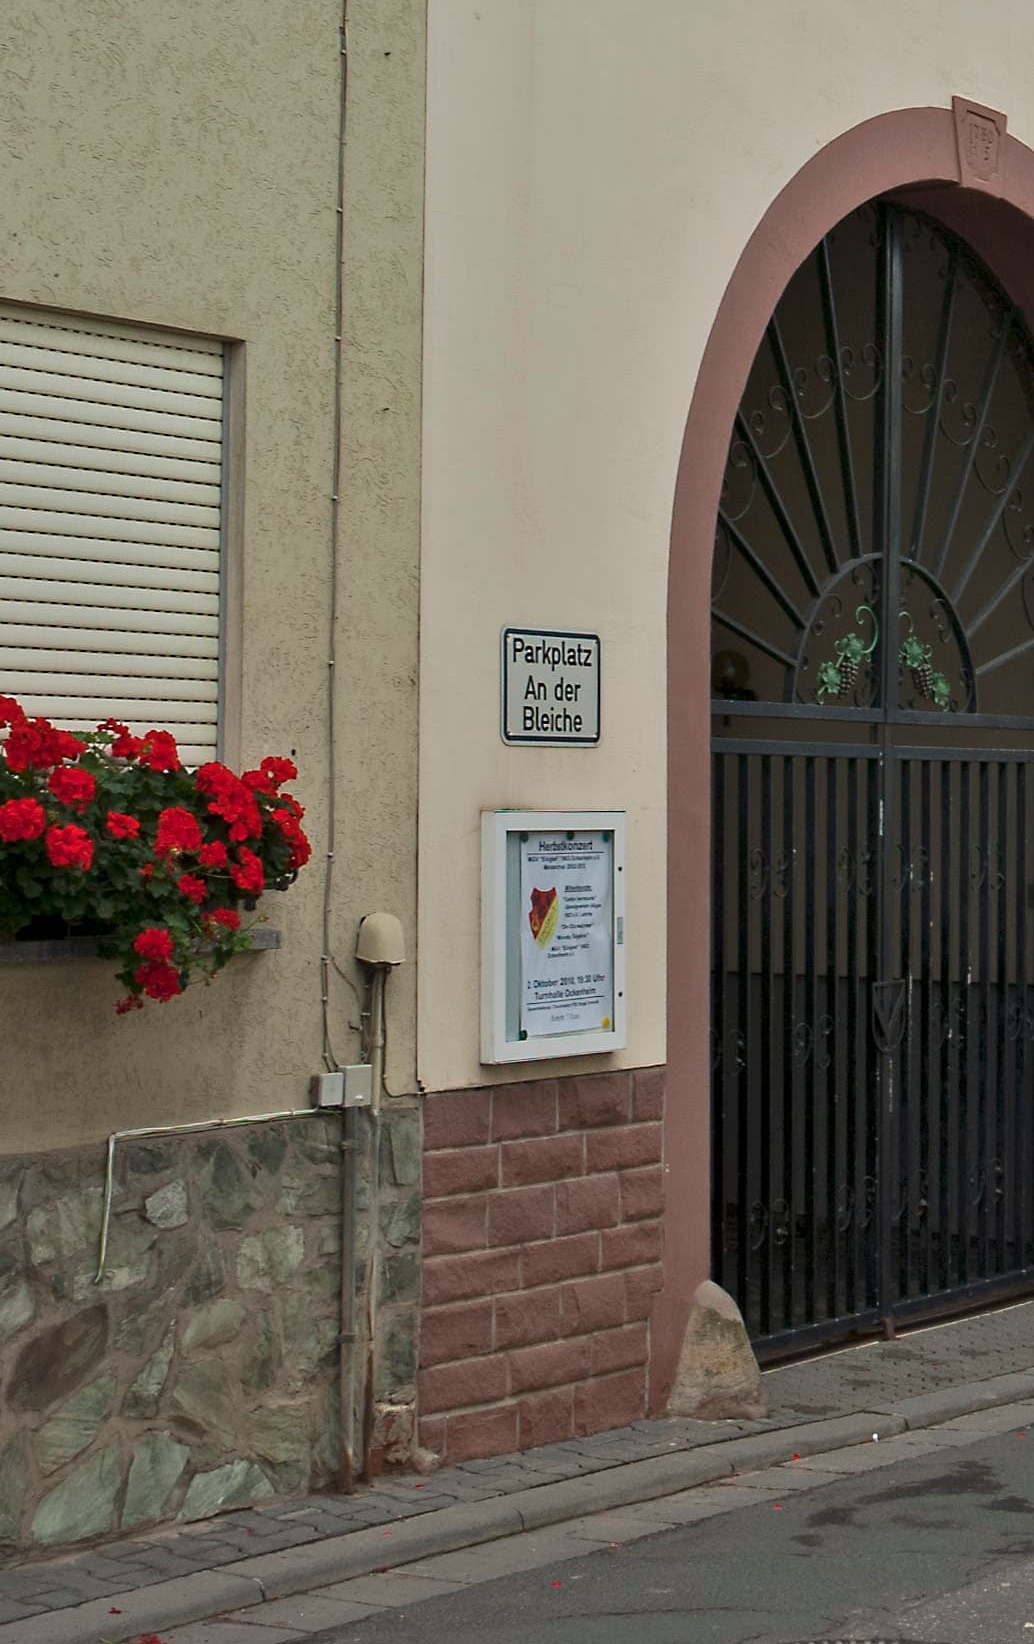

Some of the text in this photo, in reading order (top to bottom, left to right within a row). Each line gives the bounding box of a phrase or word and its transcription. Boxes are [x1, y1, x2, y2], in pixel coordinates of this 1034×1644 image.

[513, 638, 592, 672] Parkplatz
[524, 675, 581, 702] An der
[523, 706, 582, 732] Bleiche
